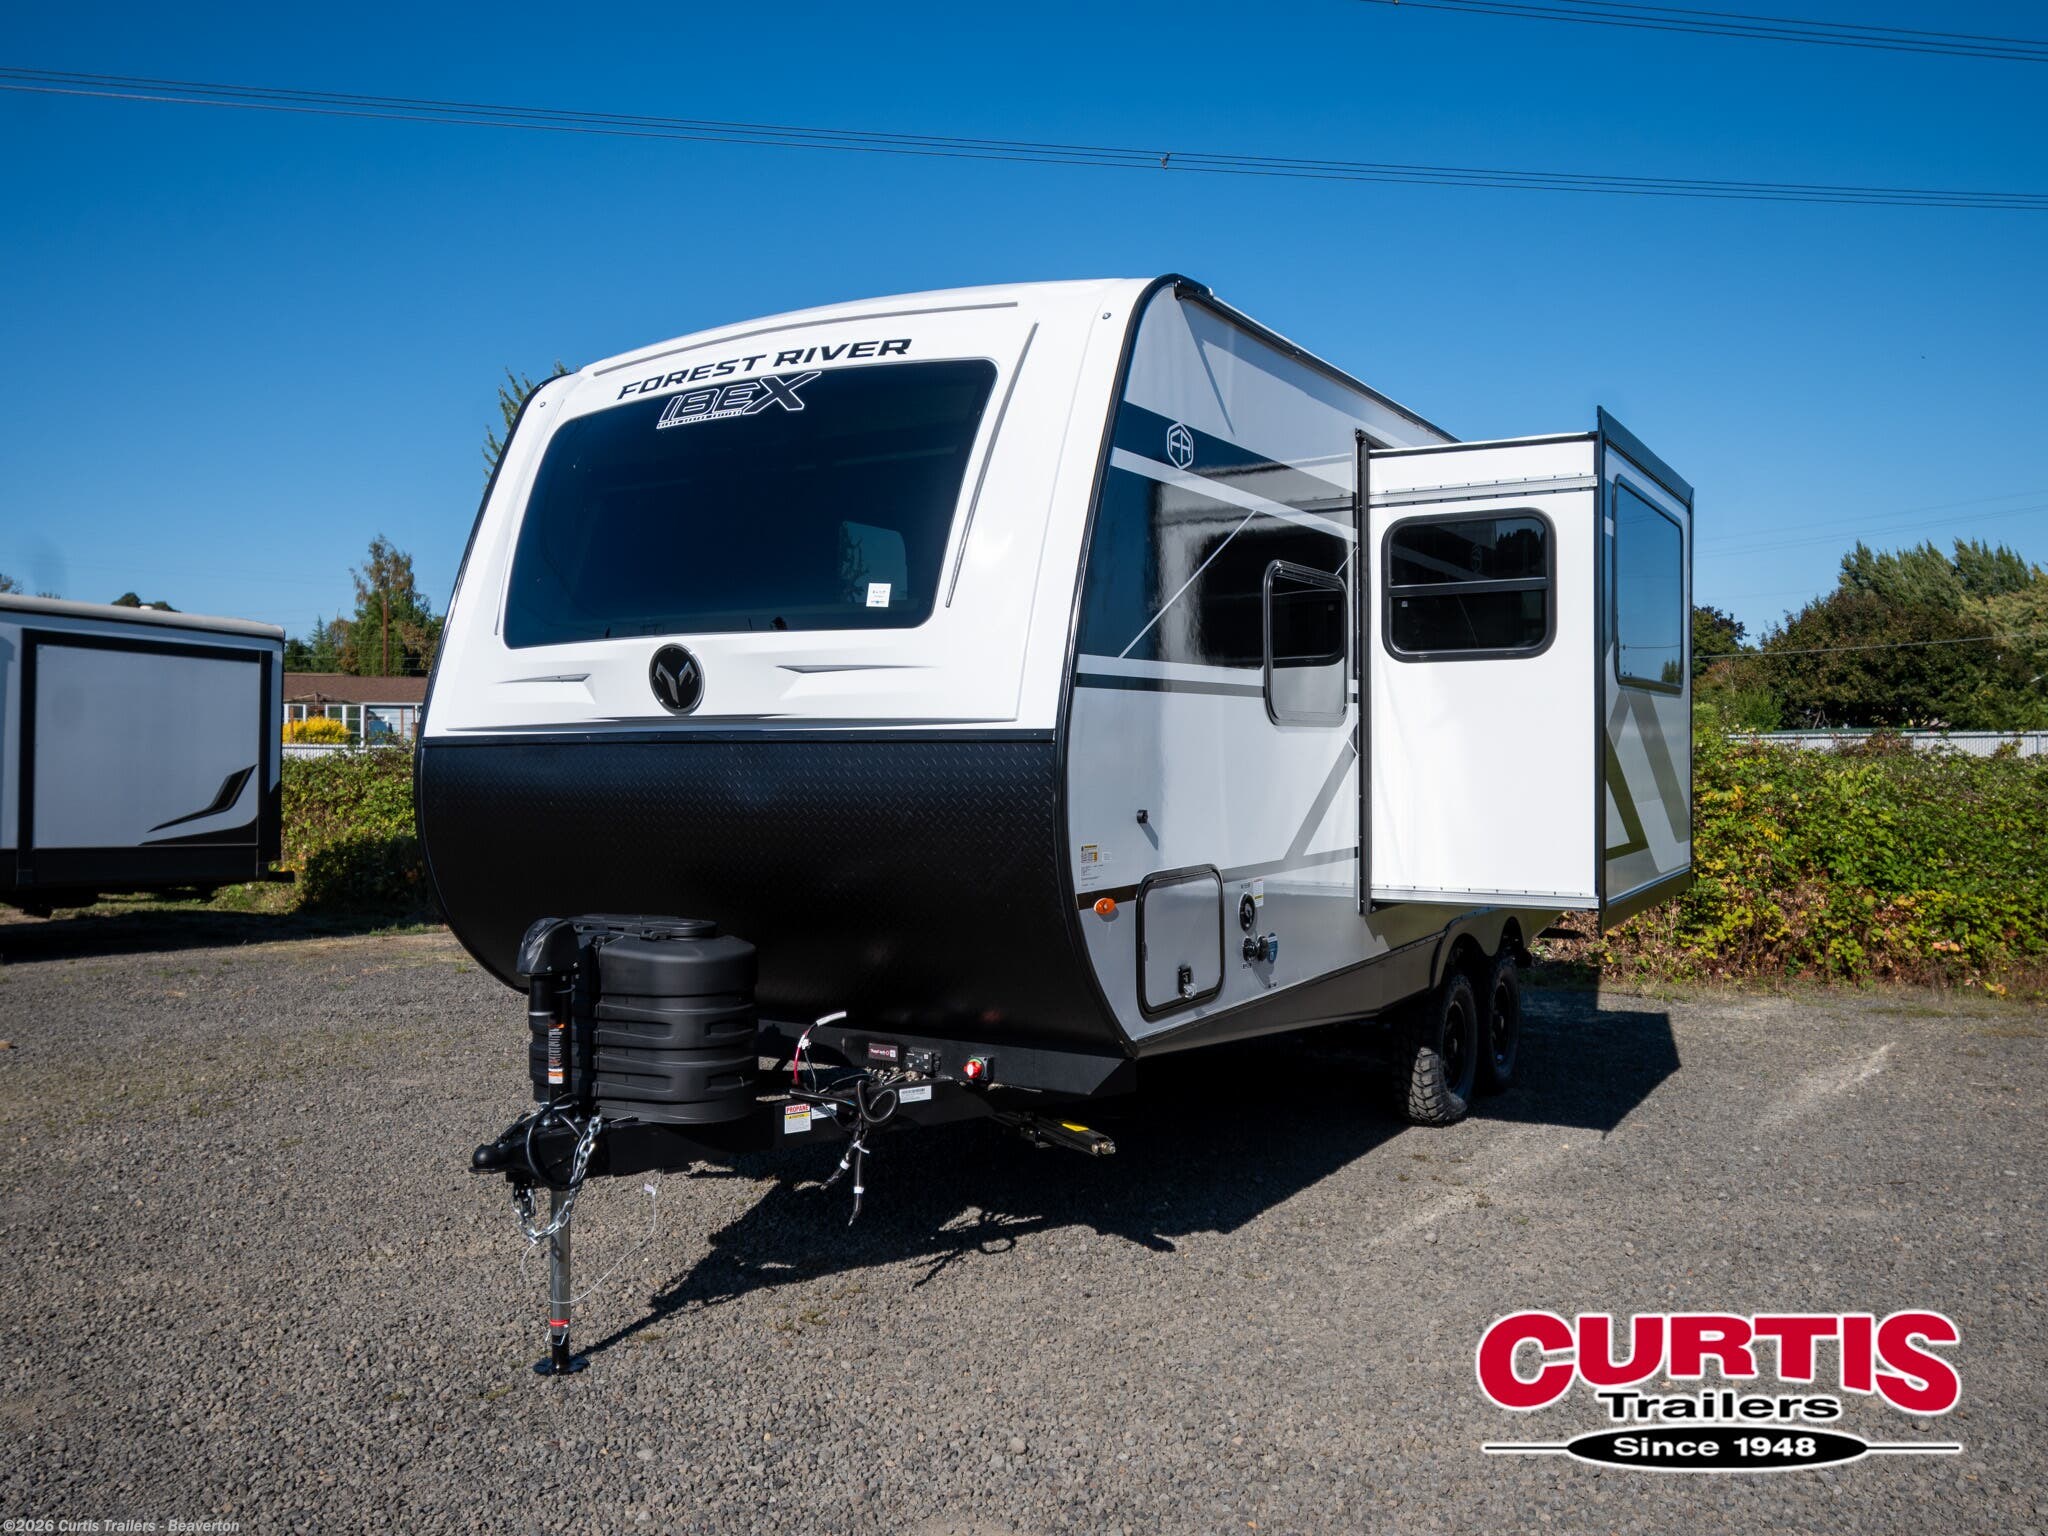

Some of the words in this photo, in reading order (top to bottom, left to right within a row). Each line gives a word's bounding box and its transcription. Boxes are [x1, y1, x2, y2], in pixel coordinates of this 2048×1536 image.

[616, 354, 768, 401] FOREST
[772, 338, 913, 368] RIVER
[659, 370, 823, 424] IBEX
[786, 1104, 810, 1114] PROPANE
